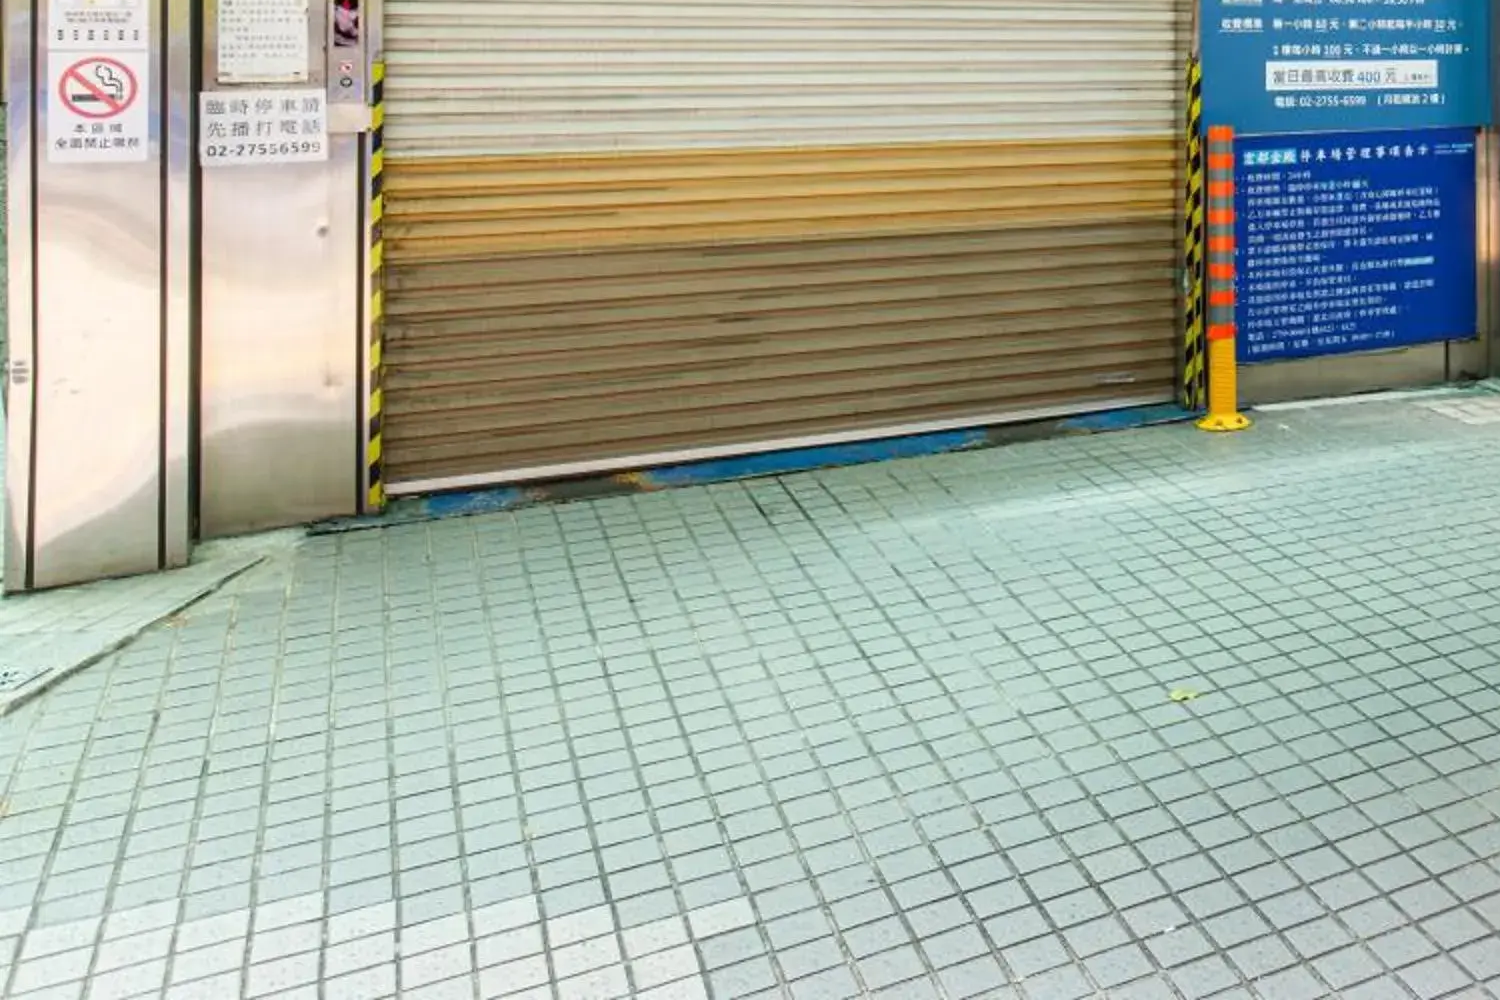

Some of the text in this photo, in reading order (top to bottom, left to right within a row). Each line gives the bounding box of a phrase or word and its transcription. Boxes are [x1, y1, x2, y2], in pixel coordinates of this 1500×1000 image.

[1323, 45, 1342, 57] 100
[1356, 70, 1381, 84] 400
[1385, 67, 1398, 84] 元
[206, 141, 321, 157] 02-27556599
